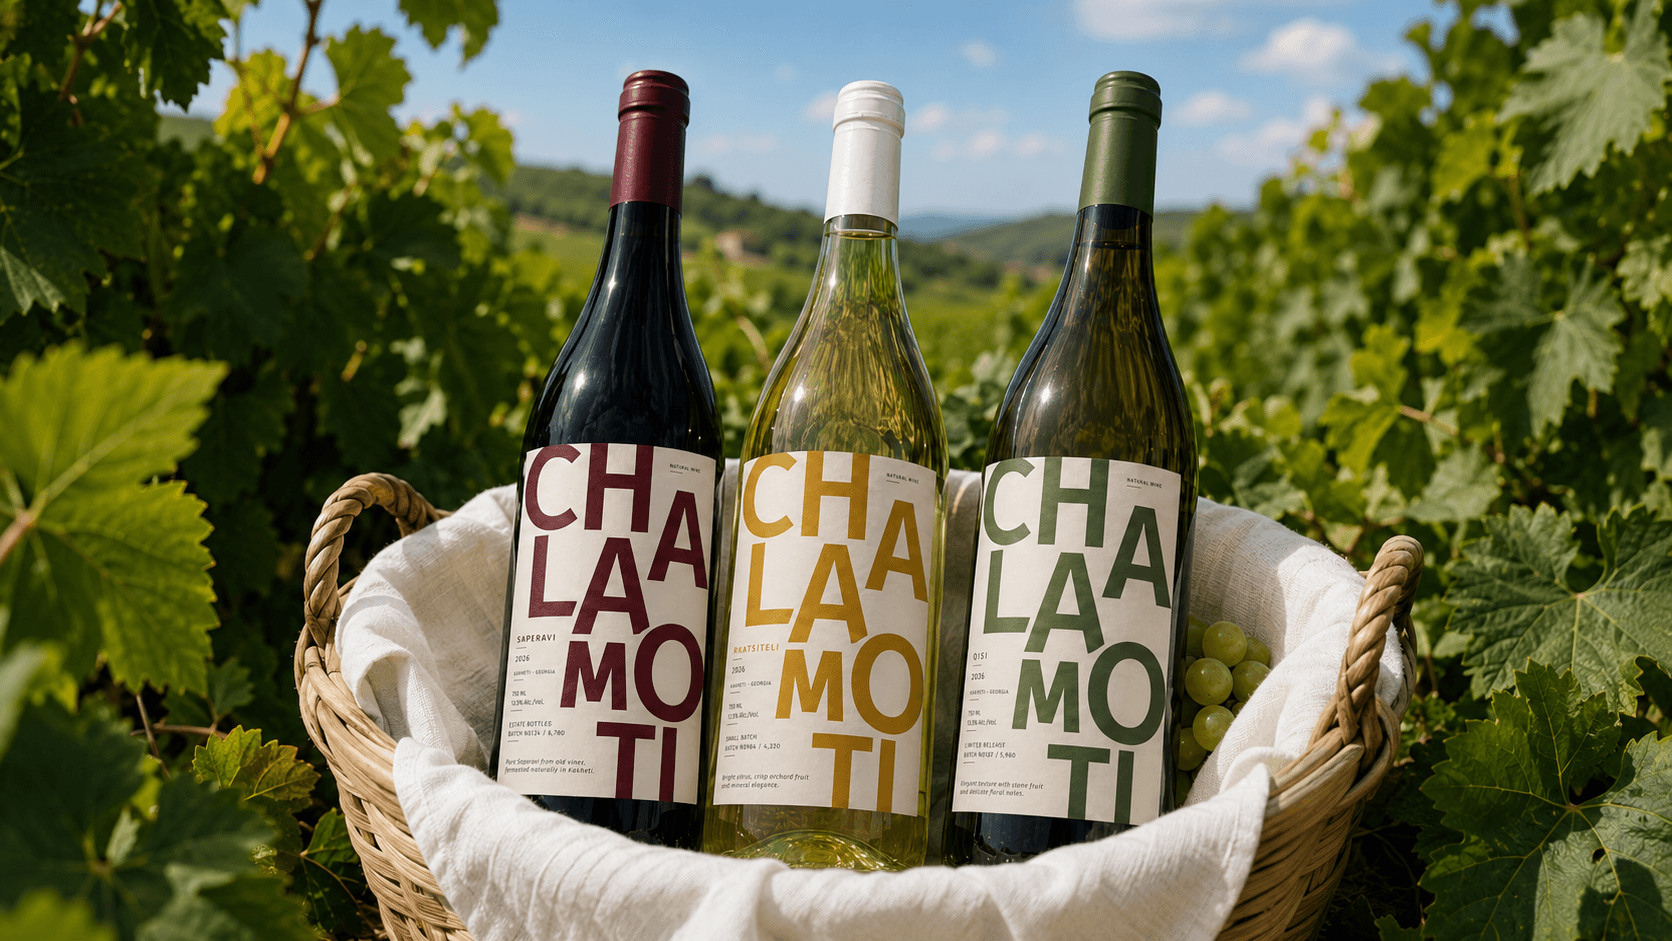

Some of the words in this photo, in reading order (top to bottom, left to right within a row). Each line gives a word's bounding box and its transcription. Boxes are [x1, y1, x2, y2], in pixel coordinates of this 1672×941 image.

[670, 463, 689, 471] NATURAL
[886, 473, 907, 481] NATURAL
[1127, 478, 1149, 486] NATURAL
[517, 634, 556, 643] SAPERAVI
[733, 643, 779, 654] RKATSITELI
[973, 652, 987, 660] QISI
[504, 767, 529, 775] fermented
[1029, 782, 1044, 790] fruit
